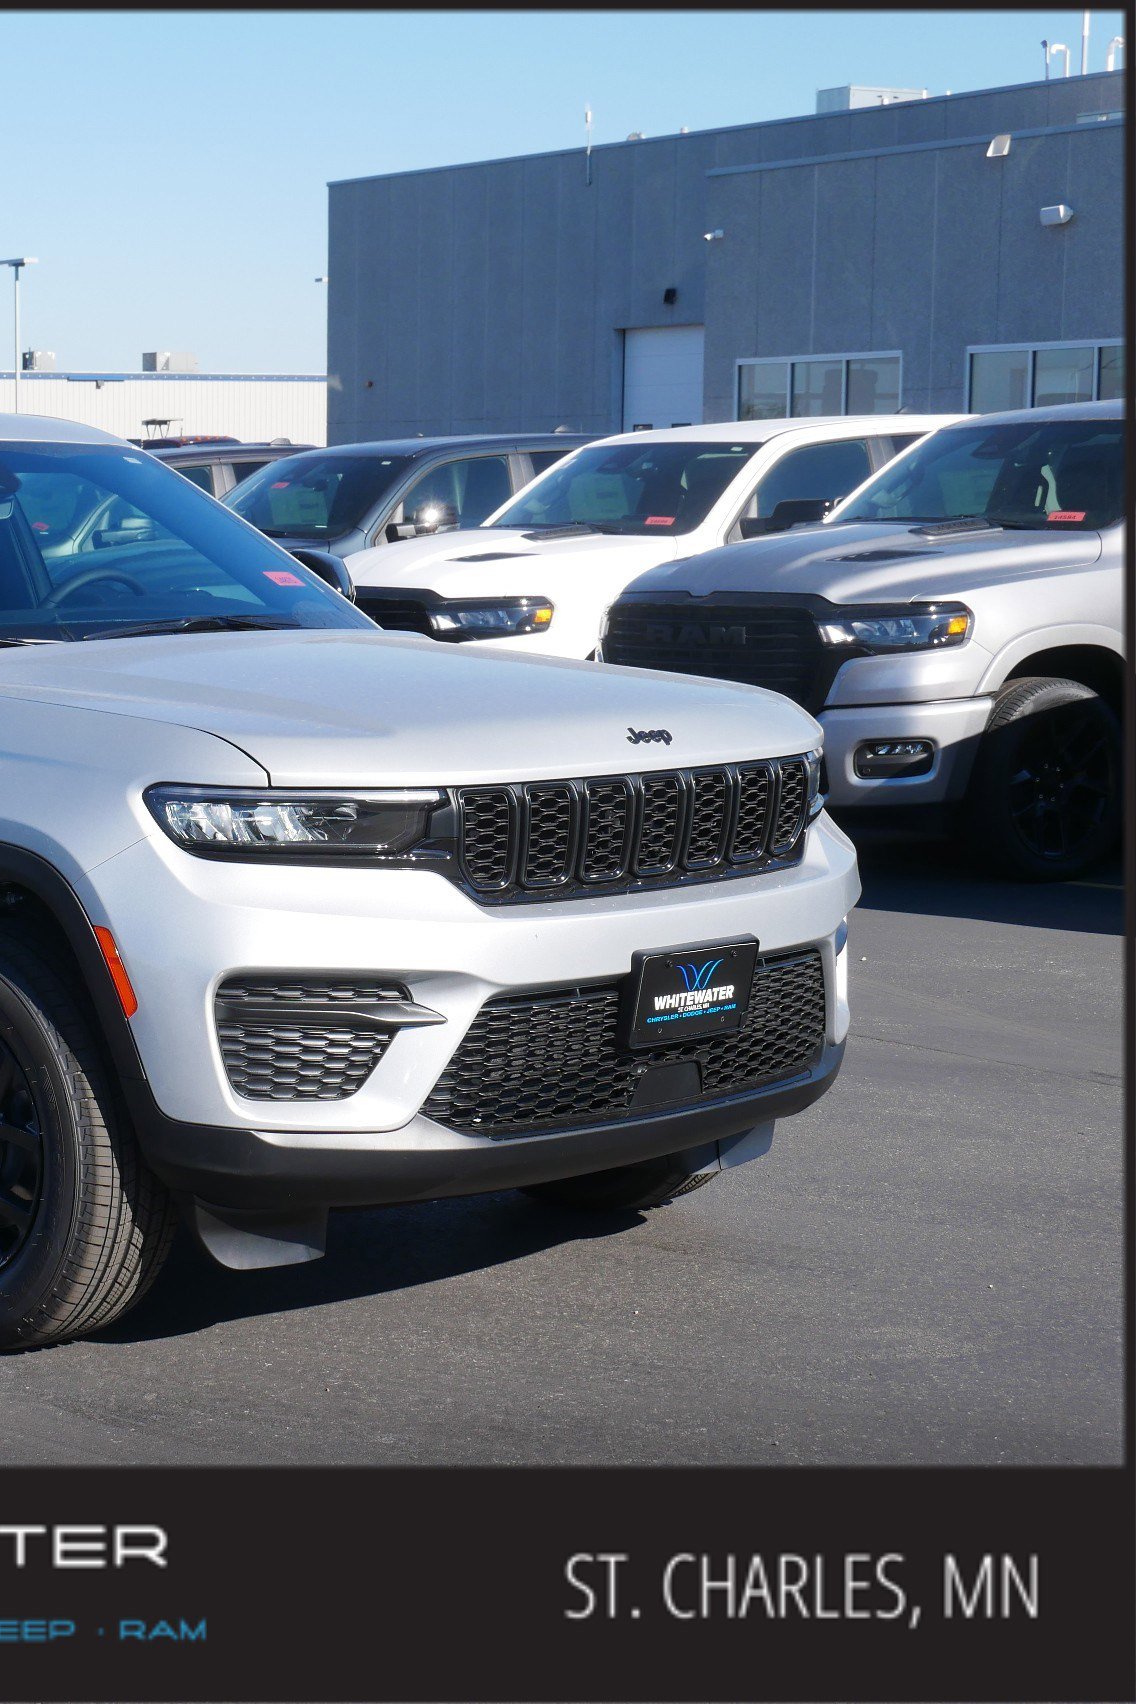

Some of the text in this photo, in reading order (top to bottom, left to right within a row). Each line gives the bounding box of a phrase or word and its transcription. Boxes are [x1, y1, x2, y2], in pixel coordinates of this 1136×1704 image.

[647, 624, 746, 645] RAM
[626, 727, 673, 746] Jeep
[654, 985, 735, 1011] WHITEWATER
[646, 1013, 679, 1023] CHRYSLER
[682, 1009, 703, 1018] DODGE
[706, 1006, 721, 1014] JEEP
